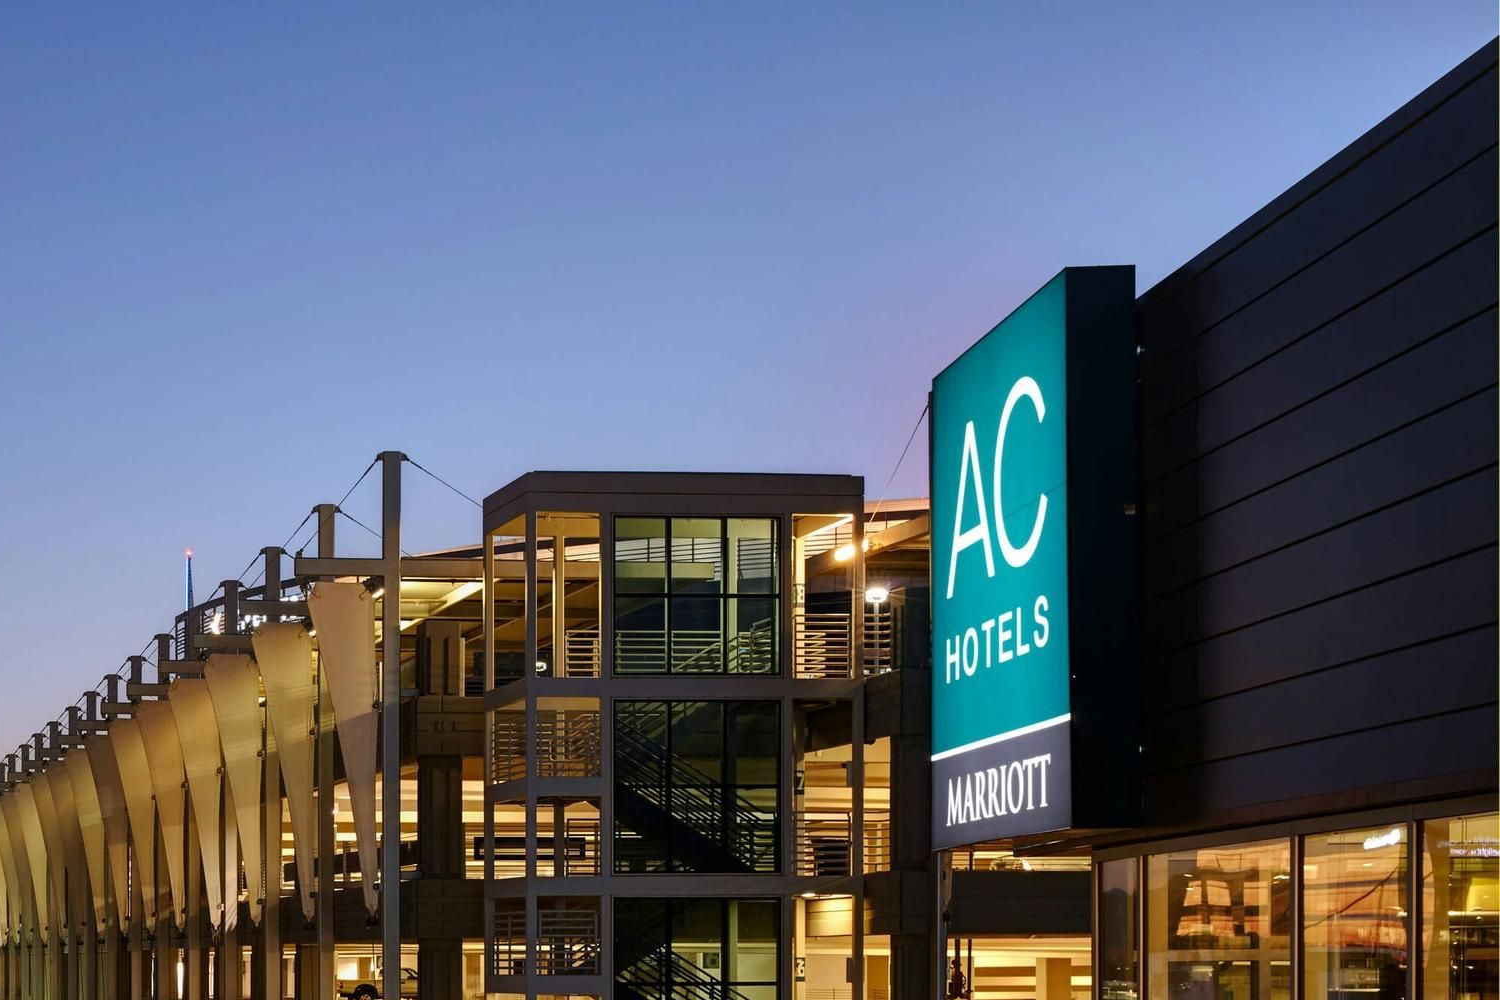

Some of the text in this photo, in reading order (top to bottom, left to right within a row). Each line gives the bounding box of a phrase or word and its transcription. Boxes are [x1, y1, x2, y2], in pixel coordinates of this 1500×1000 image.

[946, 376, 1048, 599] AC
[945, 595, 1049, 684] HOTELS
[946, 753, 1051, 827] MARRIOTT
